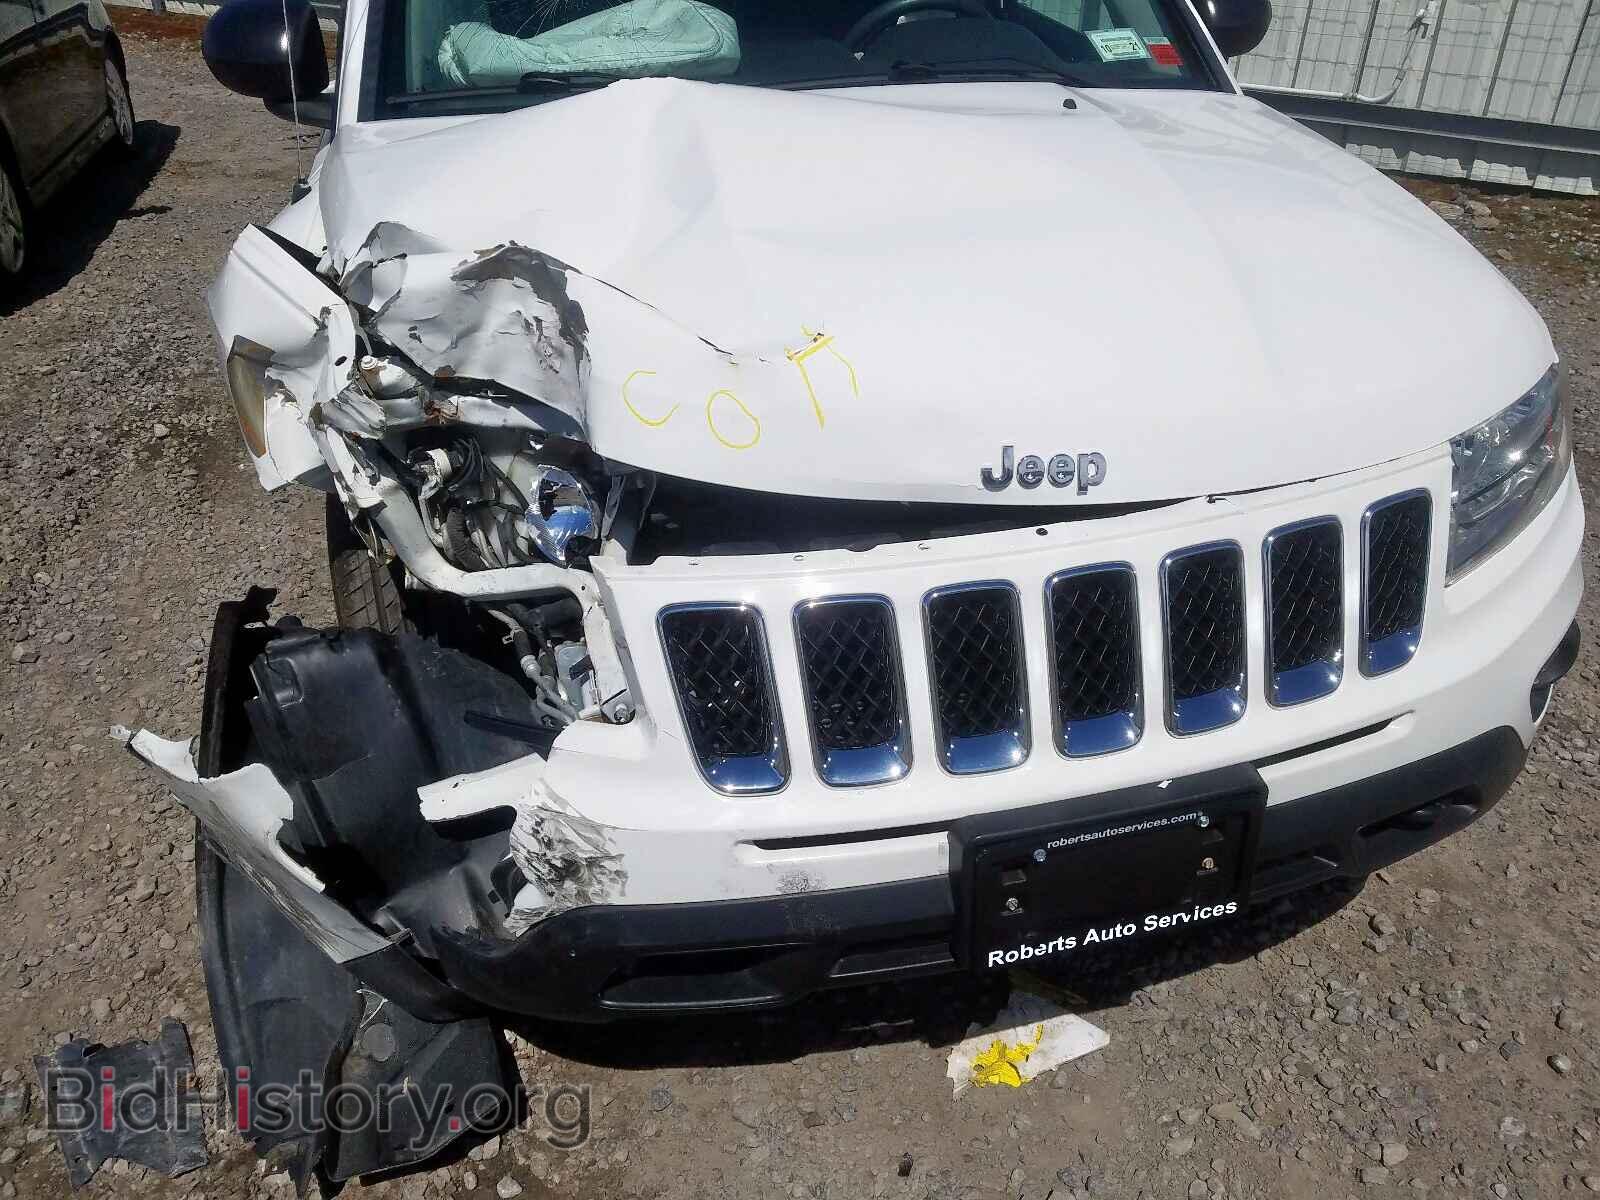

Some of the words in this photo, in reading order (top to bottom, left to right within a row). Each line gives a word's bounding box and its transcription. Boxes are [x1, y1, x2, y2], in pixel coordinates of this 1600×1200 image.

[1101, 43, 1113, 54] 10
[980, 445, 1107, 496] Jeep
[1046, 811, 1198, 849] robertsautoservices.com
[987, 934, 1078, 968] Roberts
[1082, 922, 1137, 946] Auto
[1143, 900, 1238, 932] Services
